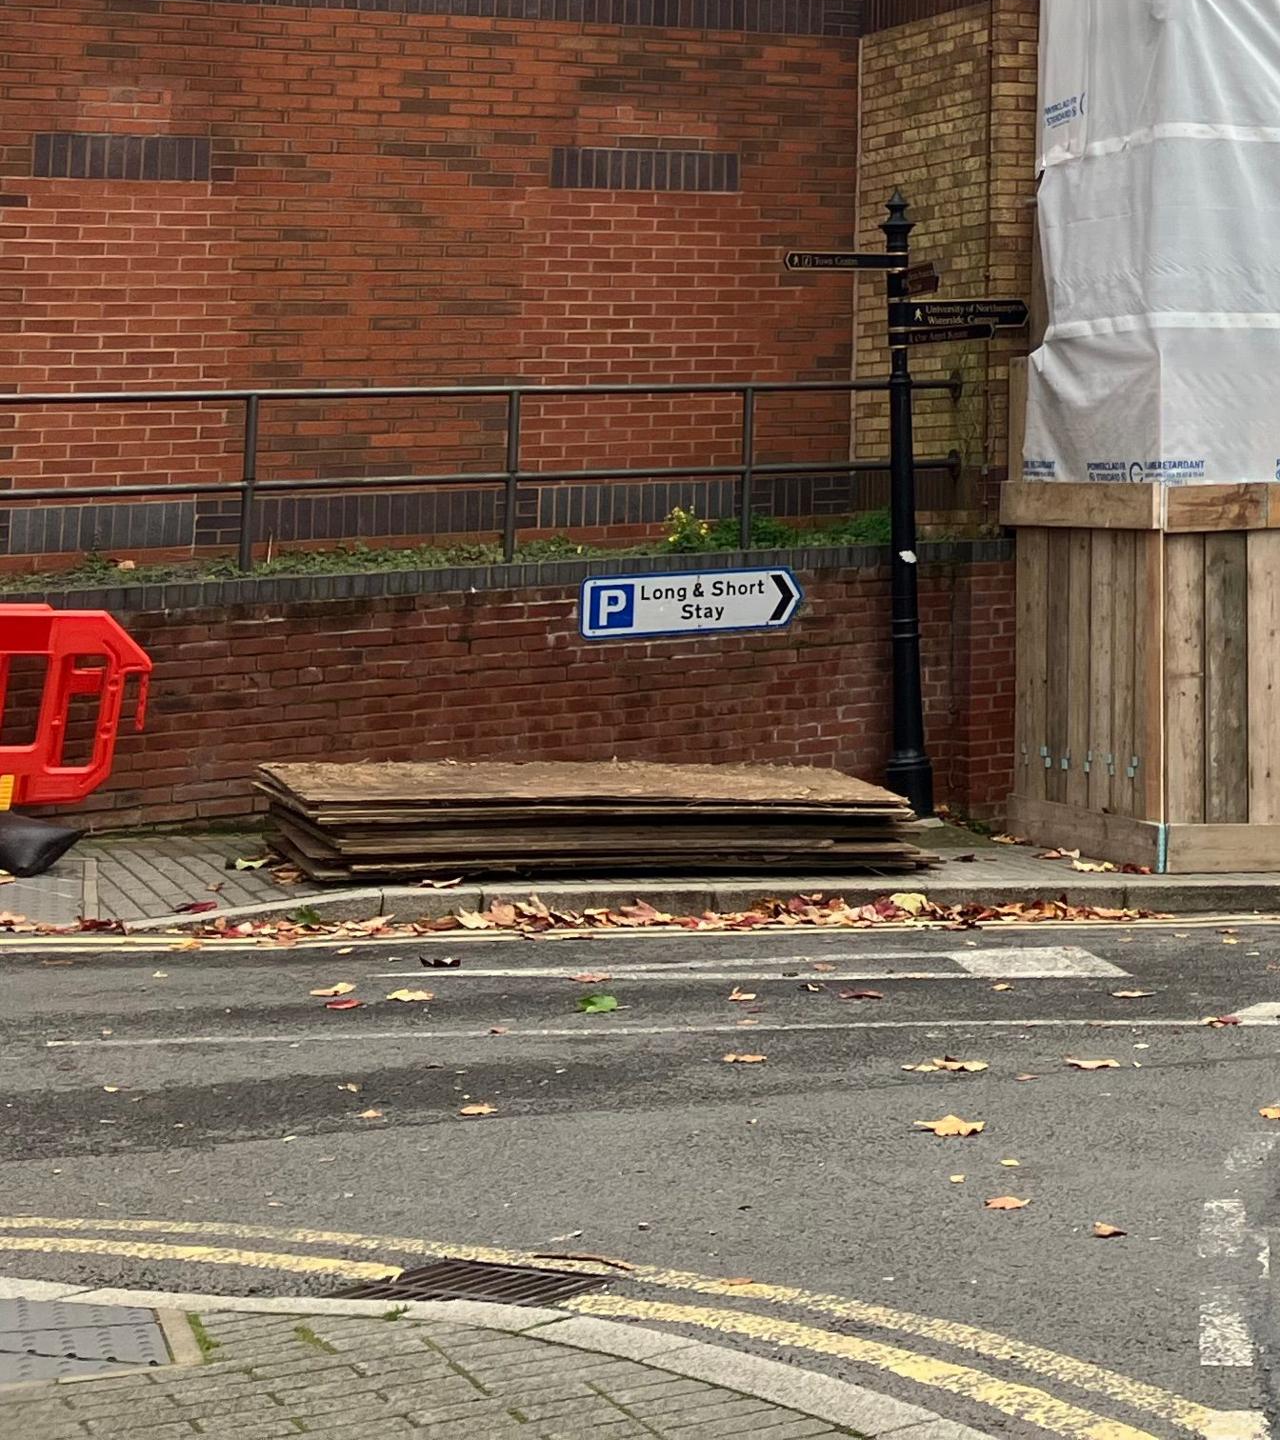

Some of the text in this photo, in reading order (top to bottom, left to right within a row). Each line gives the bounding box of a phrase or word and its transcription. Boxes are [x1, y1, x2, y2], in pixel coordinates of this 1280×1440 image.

[814, 257, 833, 265] Town
[925, 305, 964, 314] University
[976, 304, 1024, 314] Northampton
[927, 316, 964, 325] Waterside
[1161, 461, 1204, 470] RETARDANT
[641, 580, 764, 601] Long & Short
[599, 589, 627, 626] P
[681, 604, 724, 621] Stay
